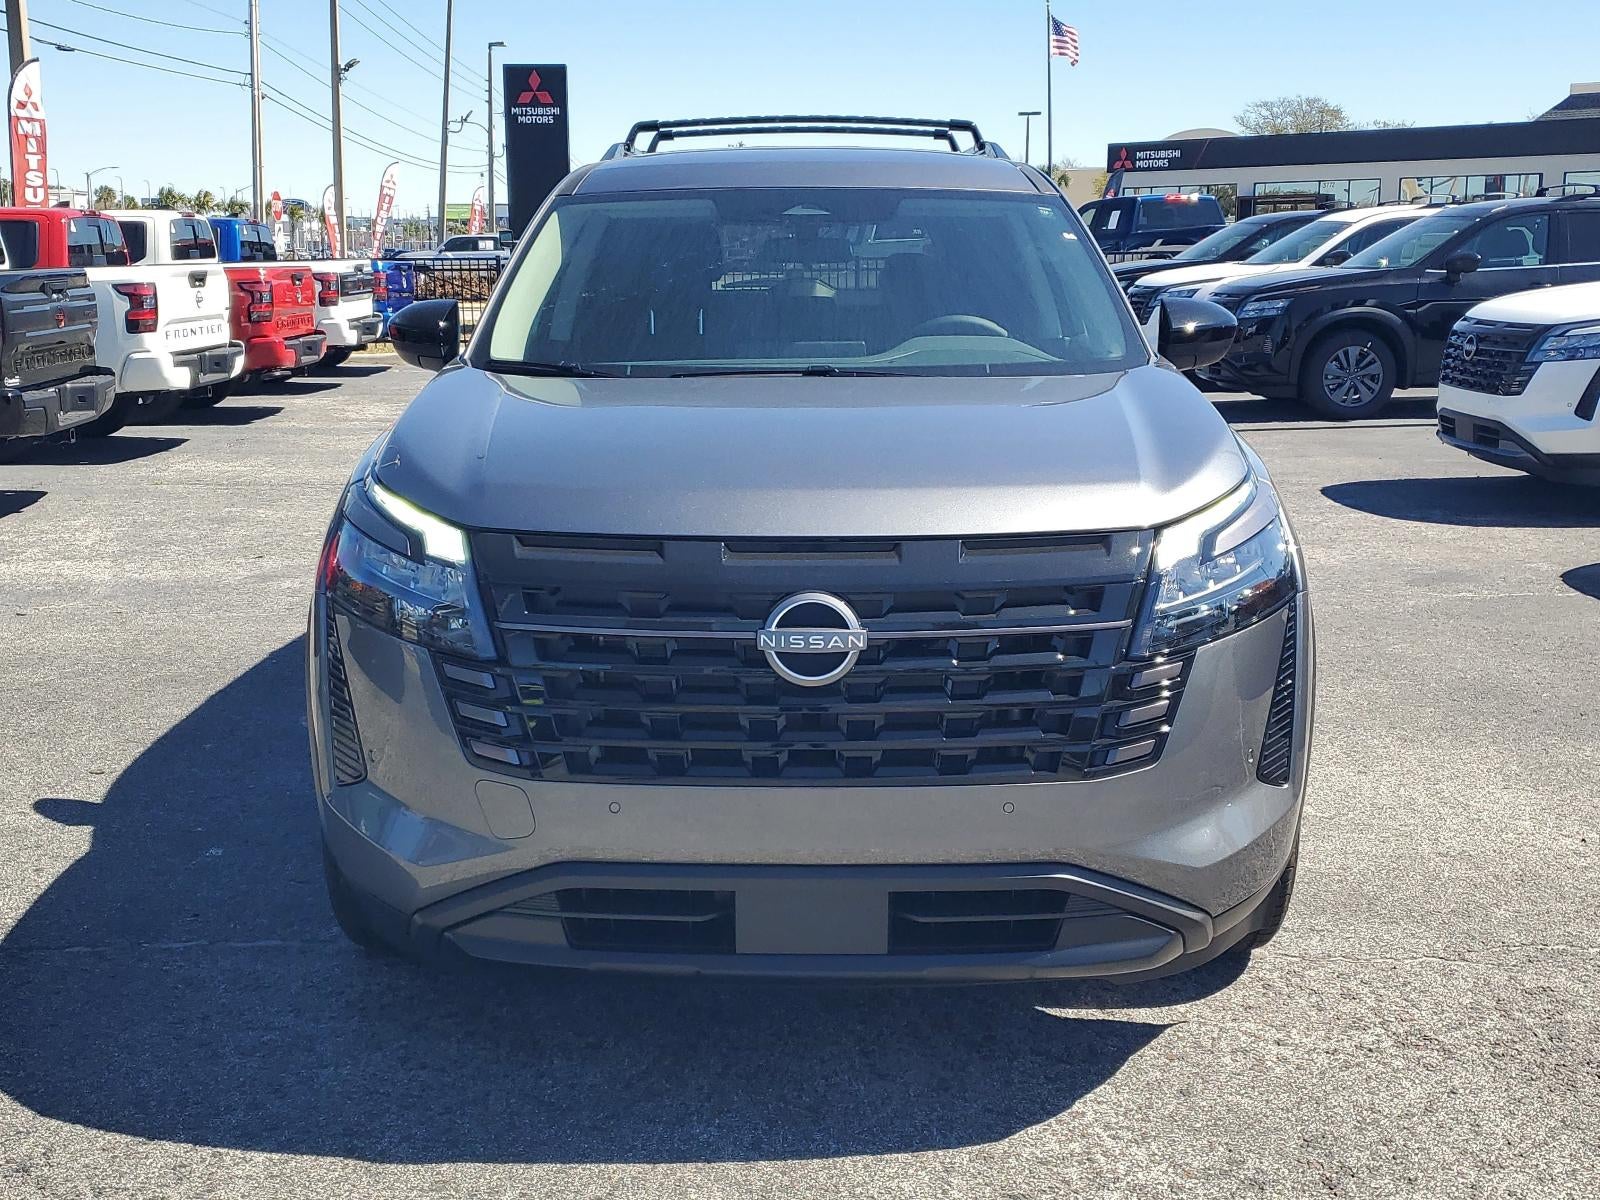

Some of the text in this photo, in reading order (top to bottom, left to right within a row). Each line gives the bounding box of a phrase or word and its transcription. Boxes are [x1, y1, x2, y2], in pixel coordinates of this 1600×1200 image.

[511, 107, 560, 115] MITSUBISHI
[517, 116, 554, 124] MOTORS
[1136, 149, 1181, 160] MITSUBISHI
[17, 119, 45, 207] MITSU
[1136, 159, 1169, 168] MOTORS
[165, 323, 223, 340] FRONTIER
[760, 634, 864, 649] NISSAN
